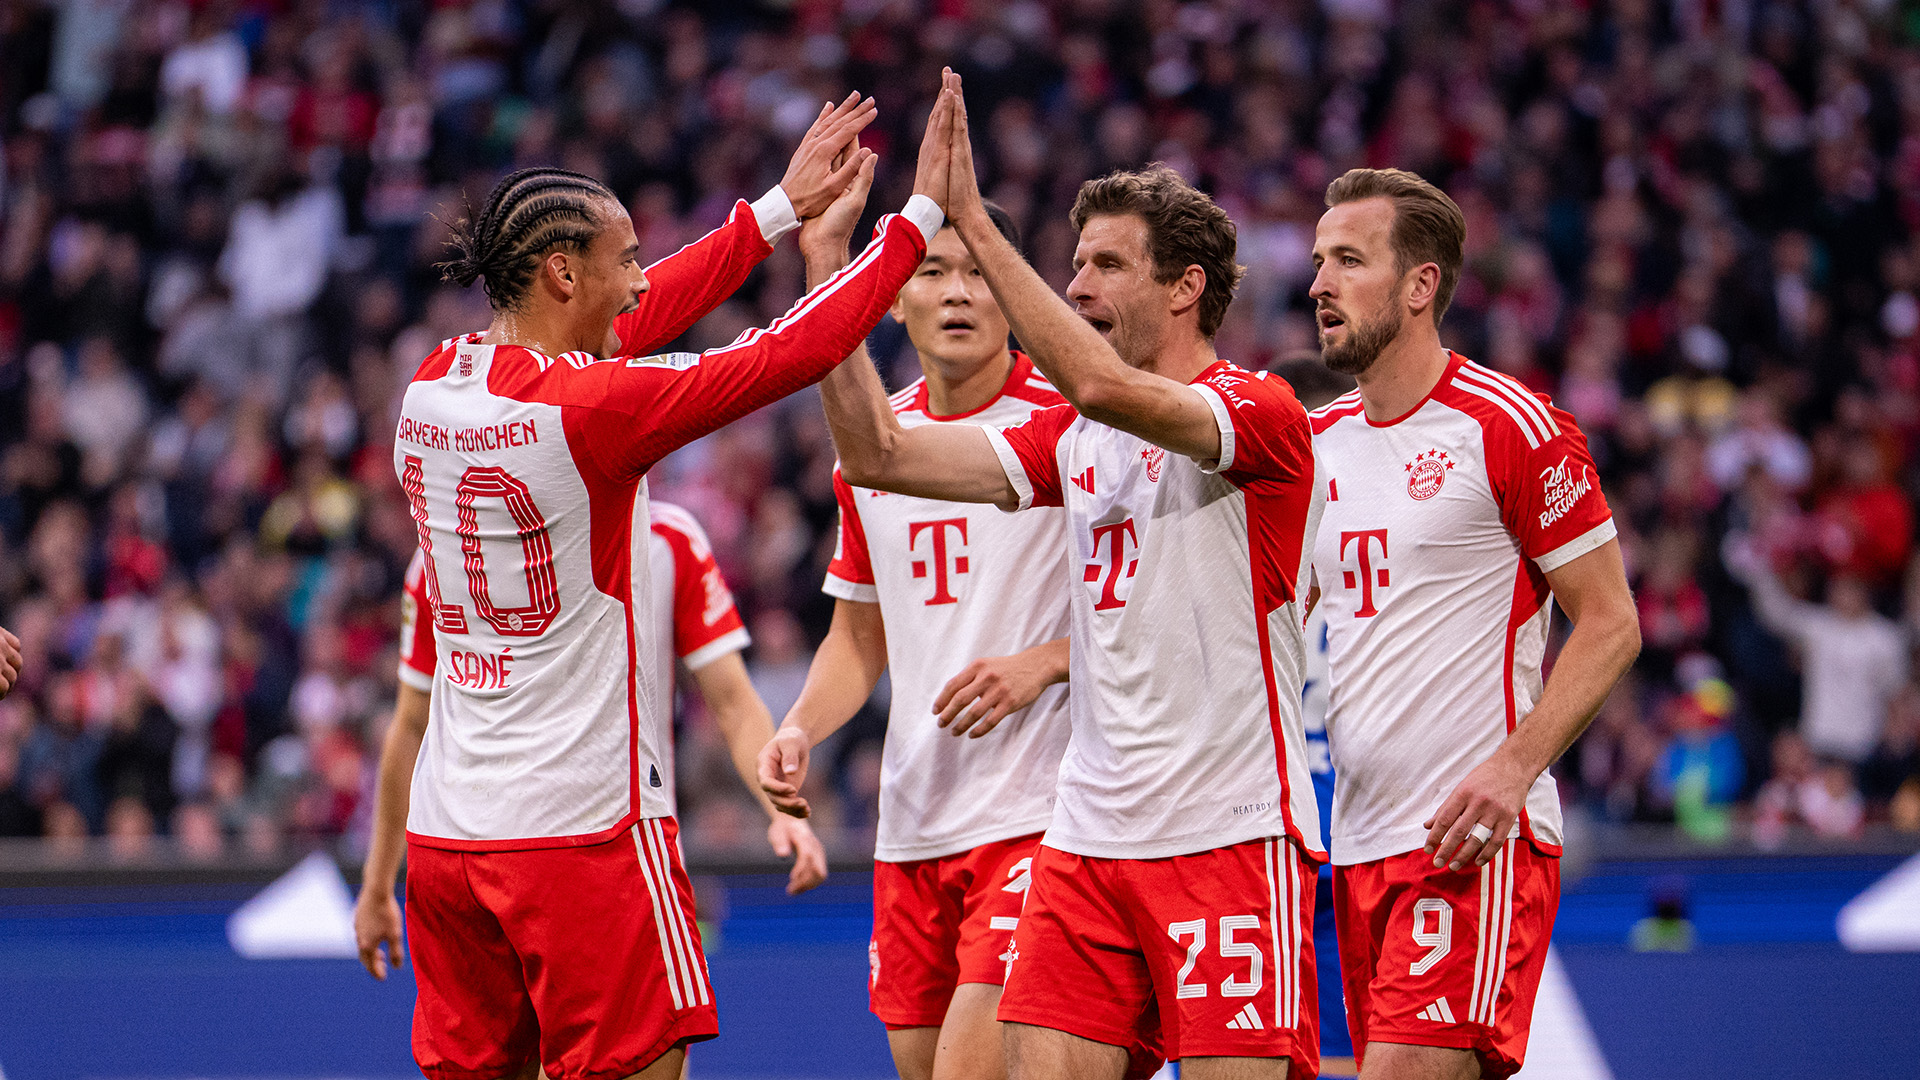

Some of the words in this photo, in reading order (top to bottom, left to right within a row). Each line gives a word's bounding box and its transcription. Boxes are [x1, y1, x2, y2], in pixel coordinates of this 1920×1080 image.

[459, 361, 472, 369] SAN
[399, 415, 450, 451] BAYERN
[455, 418, 538, 452] MÜNCHEN
[1538, 465, 1592, 530] RASSISMUS
[1539, 455, 1568, 493] ROT
[1545, 467, 1574, 507] GEGEN
[402, 455, 561, 636] 10
[909, 517, 968, 606] T
[1083, 517, 1139, 612] T
[1340, 528, 1390, 618] T
[447, 647, 514, 690] SANÉ
[1167, 915, 1263, 998] 25
[1409, 898, 1453, 976] 9
